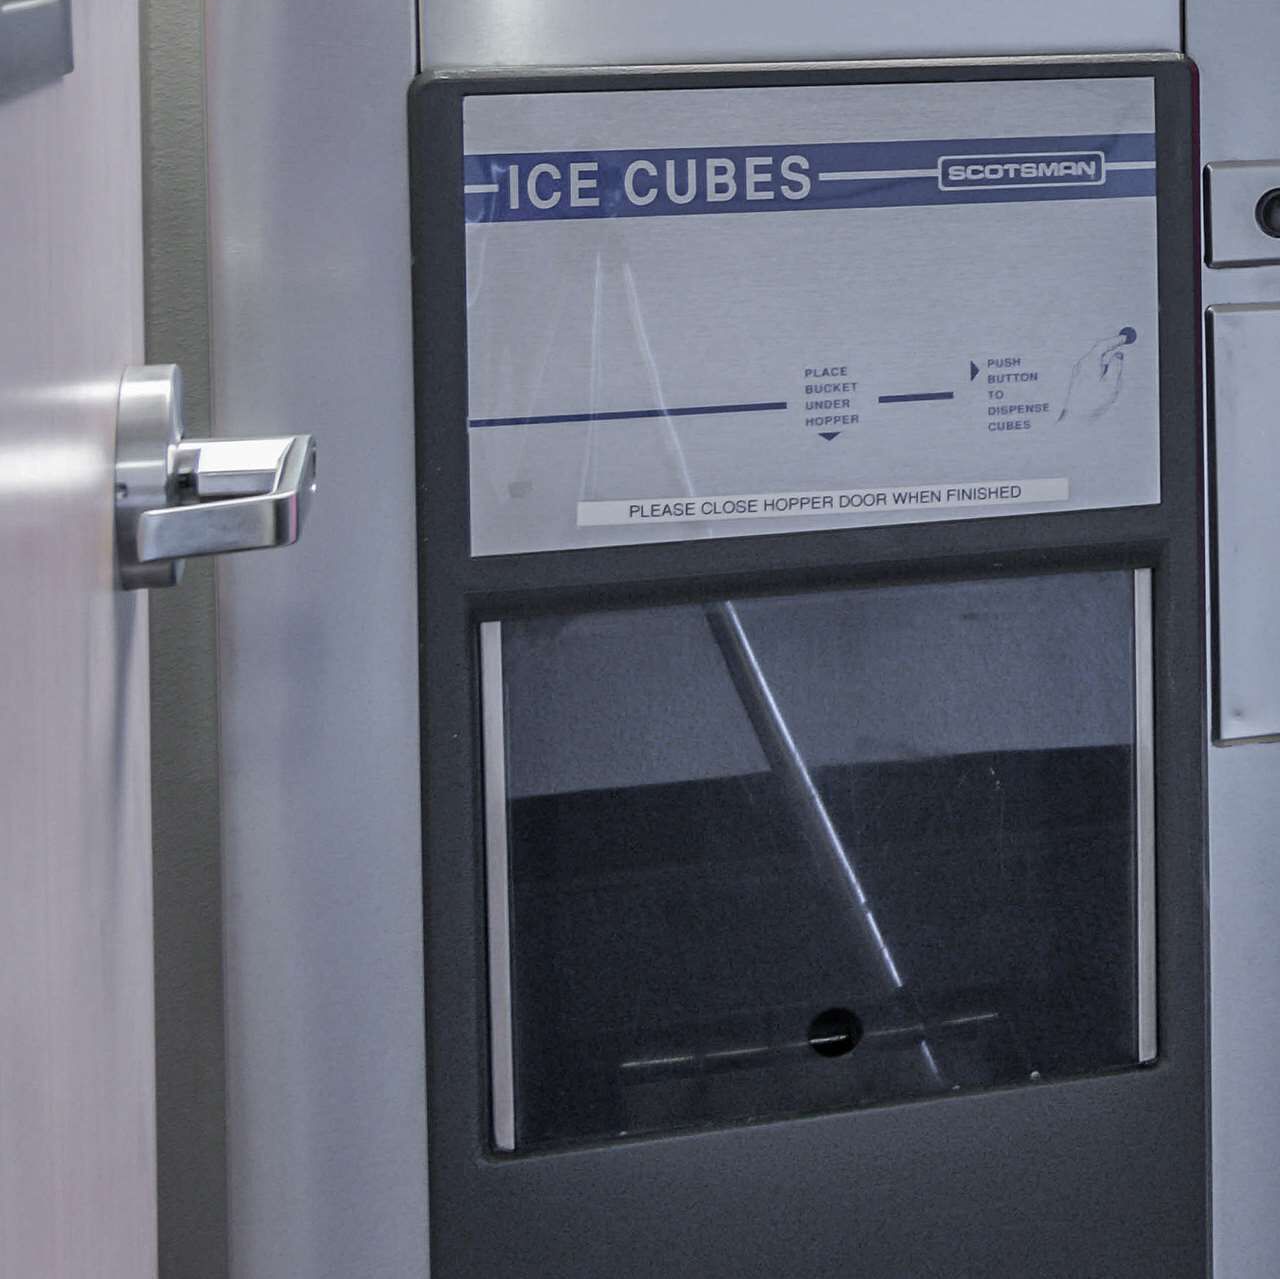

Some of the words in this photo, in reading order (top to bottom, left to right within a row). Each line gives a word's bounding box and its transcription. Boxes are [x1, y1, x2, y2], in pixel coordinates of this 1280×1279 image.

[946, 160, 1097, 181] SCOTSMAN
[508, 161, 600, 211] ICE
[623, 153, 814, 208] CUBES
[987, 357, 1022, 369] PUSH
[804, 366, 848, 378] PLACE
[987, 372, 1039, 385] BUTTON
[804, 381, 858, 395] BUCKET
[987, 389, 1005, 401] TO
[804, 398, 851, 412] UNDER
[987, 402, 1050, 417] DISPENSE
[805, 413, 860, 428] HOPPER
[987, 419, 1033, 433] CUBES
[629, 501, 697, 519] PLEASE
[700, 499, 759, 517] CLOSE
[763, 495, 835, 514] HOPPER
[839, 491, 888, 510] DOOR
[892, 488, 943, 506] WHEN
[946, 484, 1022, 503] FINISHED
